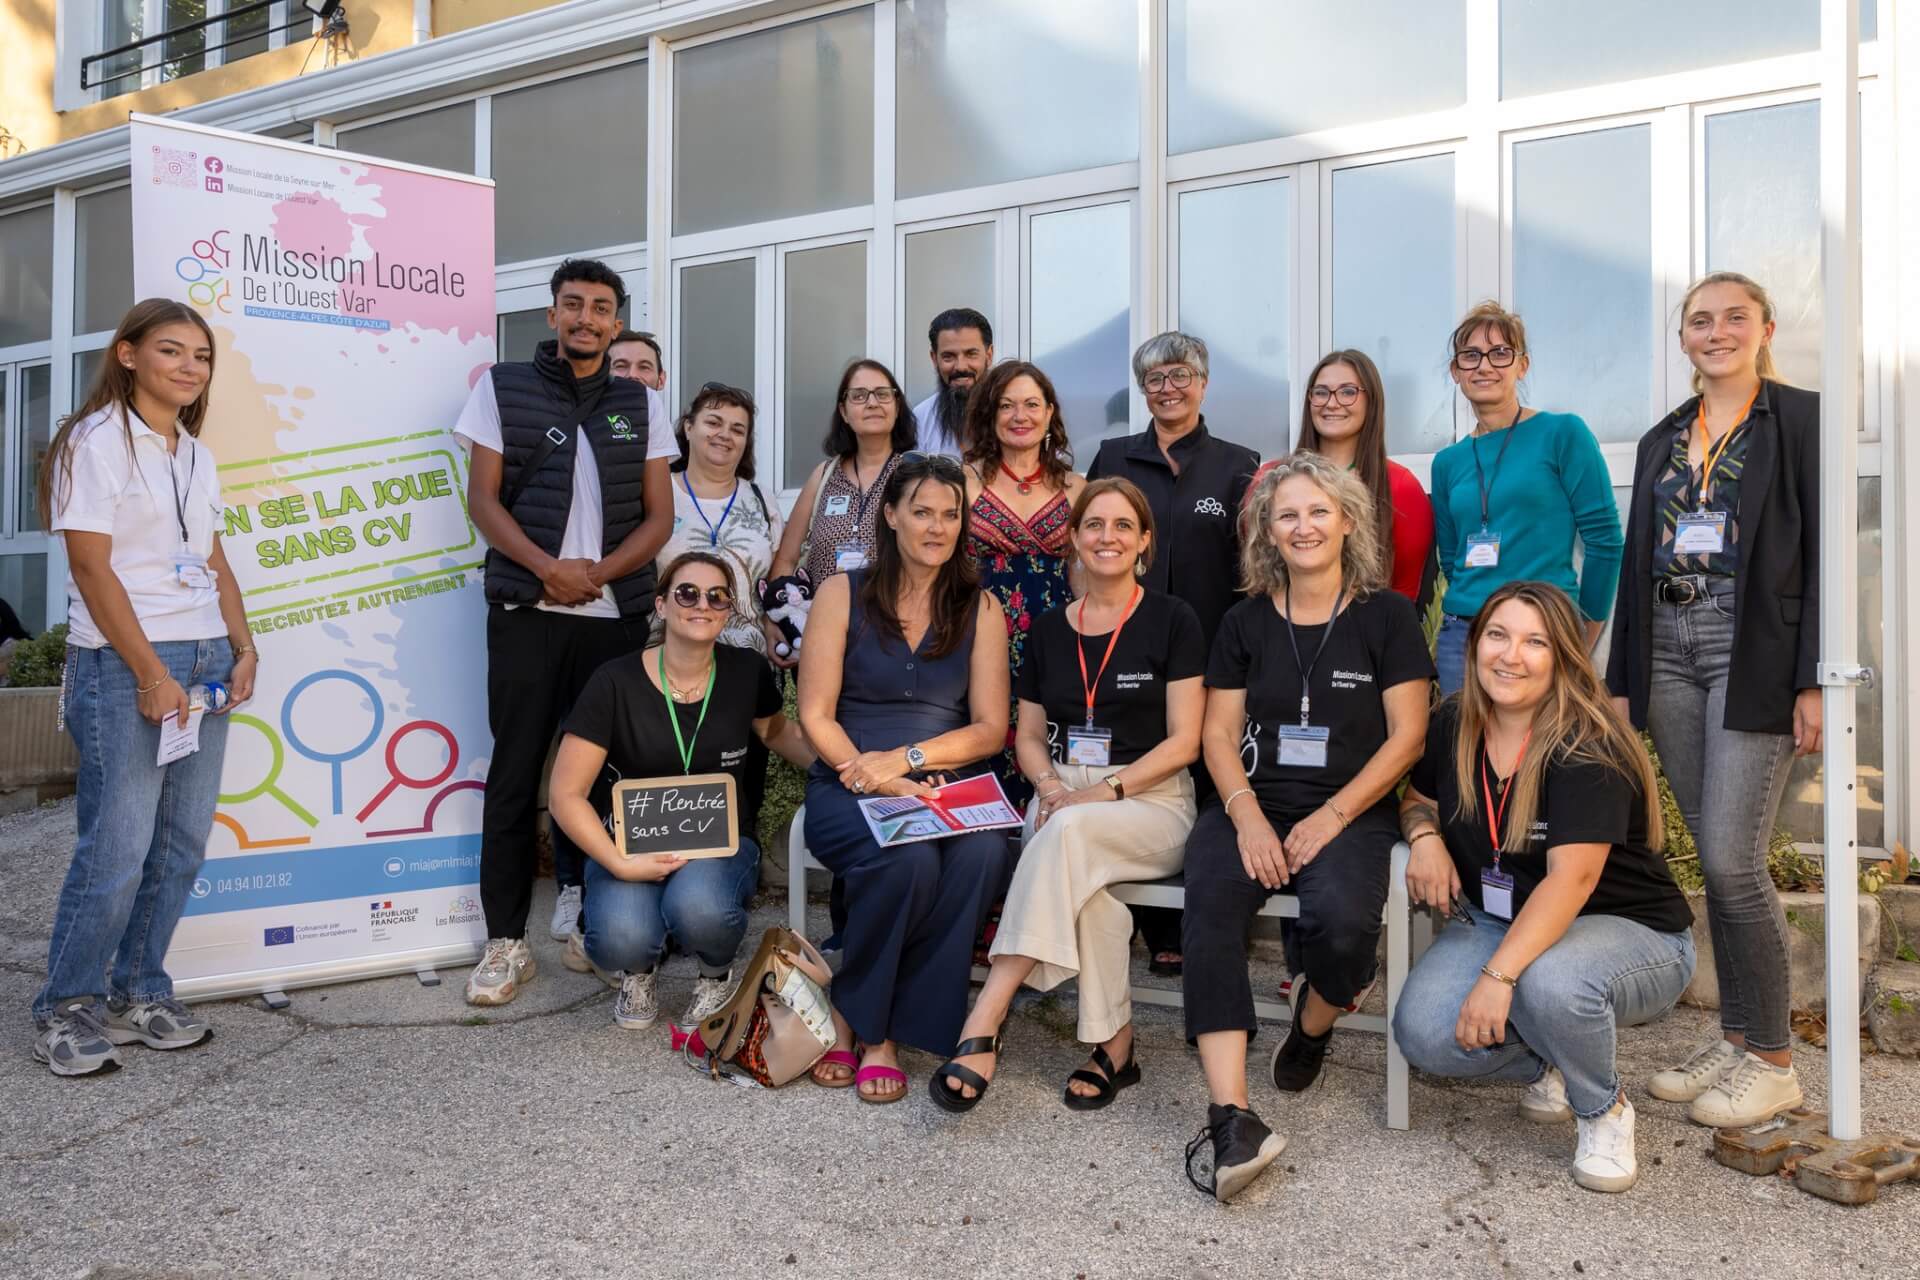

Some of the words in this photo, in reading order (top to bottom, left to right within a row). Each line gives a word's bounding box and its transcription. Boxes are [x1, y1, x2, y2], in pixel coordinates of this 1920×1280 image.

[226, 164, 251, 177] Mission
[253, 169, 273, 181] Locale
[274, 173, 283, 182] de
[283, 175, 290, 183] la
[322, 180, 337, 190] Mer
[227, 183, 252, 196] Mission
[253, 188, 274, 200] Locale
[275, 191, 283, 200] de
[243, 232, 365, 288] Mission
[375, 252, 466, 298] Locale
[243, 276, 267, 303] De
[272, 279, 339, 311] l'Ouest
[342, 289, 377, 315] Var
[218, 504, 252, 536] N
[258, 494, 309, 528] SE
[312, 485, 367, 519] LA
[372, 468, 452, 509] JOUE
[256, 524, 356, 568] SANS
[362, 512, 412, 547] CV
[248, 600, 351, 635] RECRUTEZ
[357, 573, 468, 613] AUTREMENT
[1333, 670, 1355, 680] Mission
[660, 789, 726, 814] Rentrée
[632, 825, 669, 839] sans
[678, 817, 714, 833] CV
[371, 907, 419, 919] RÉPUBLIQUE
[371, 915, 416, 926] FRANÇAISE
[435, 916, 448, 926] Les
[449, 912, 480, 924] Missions
